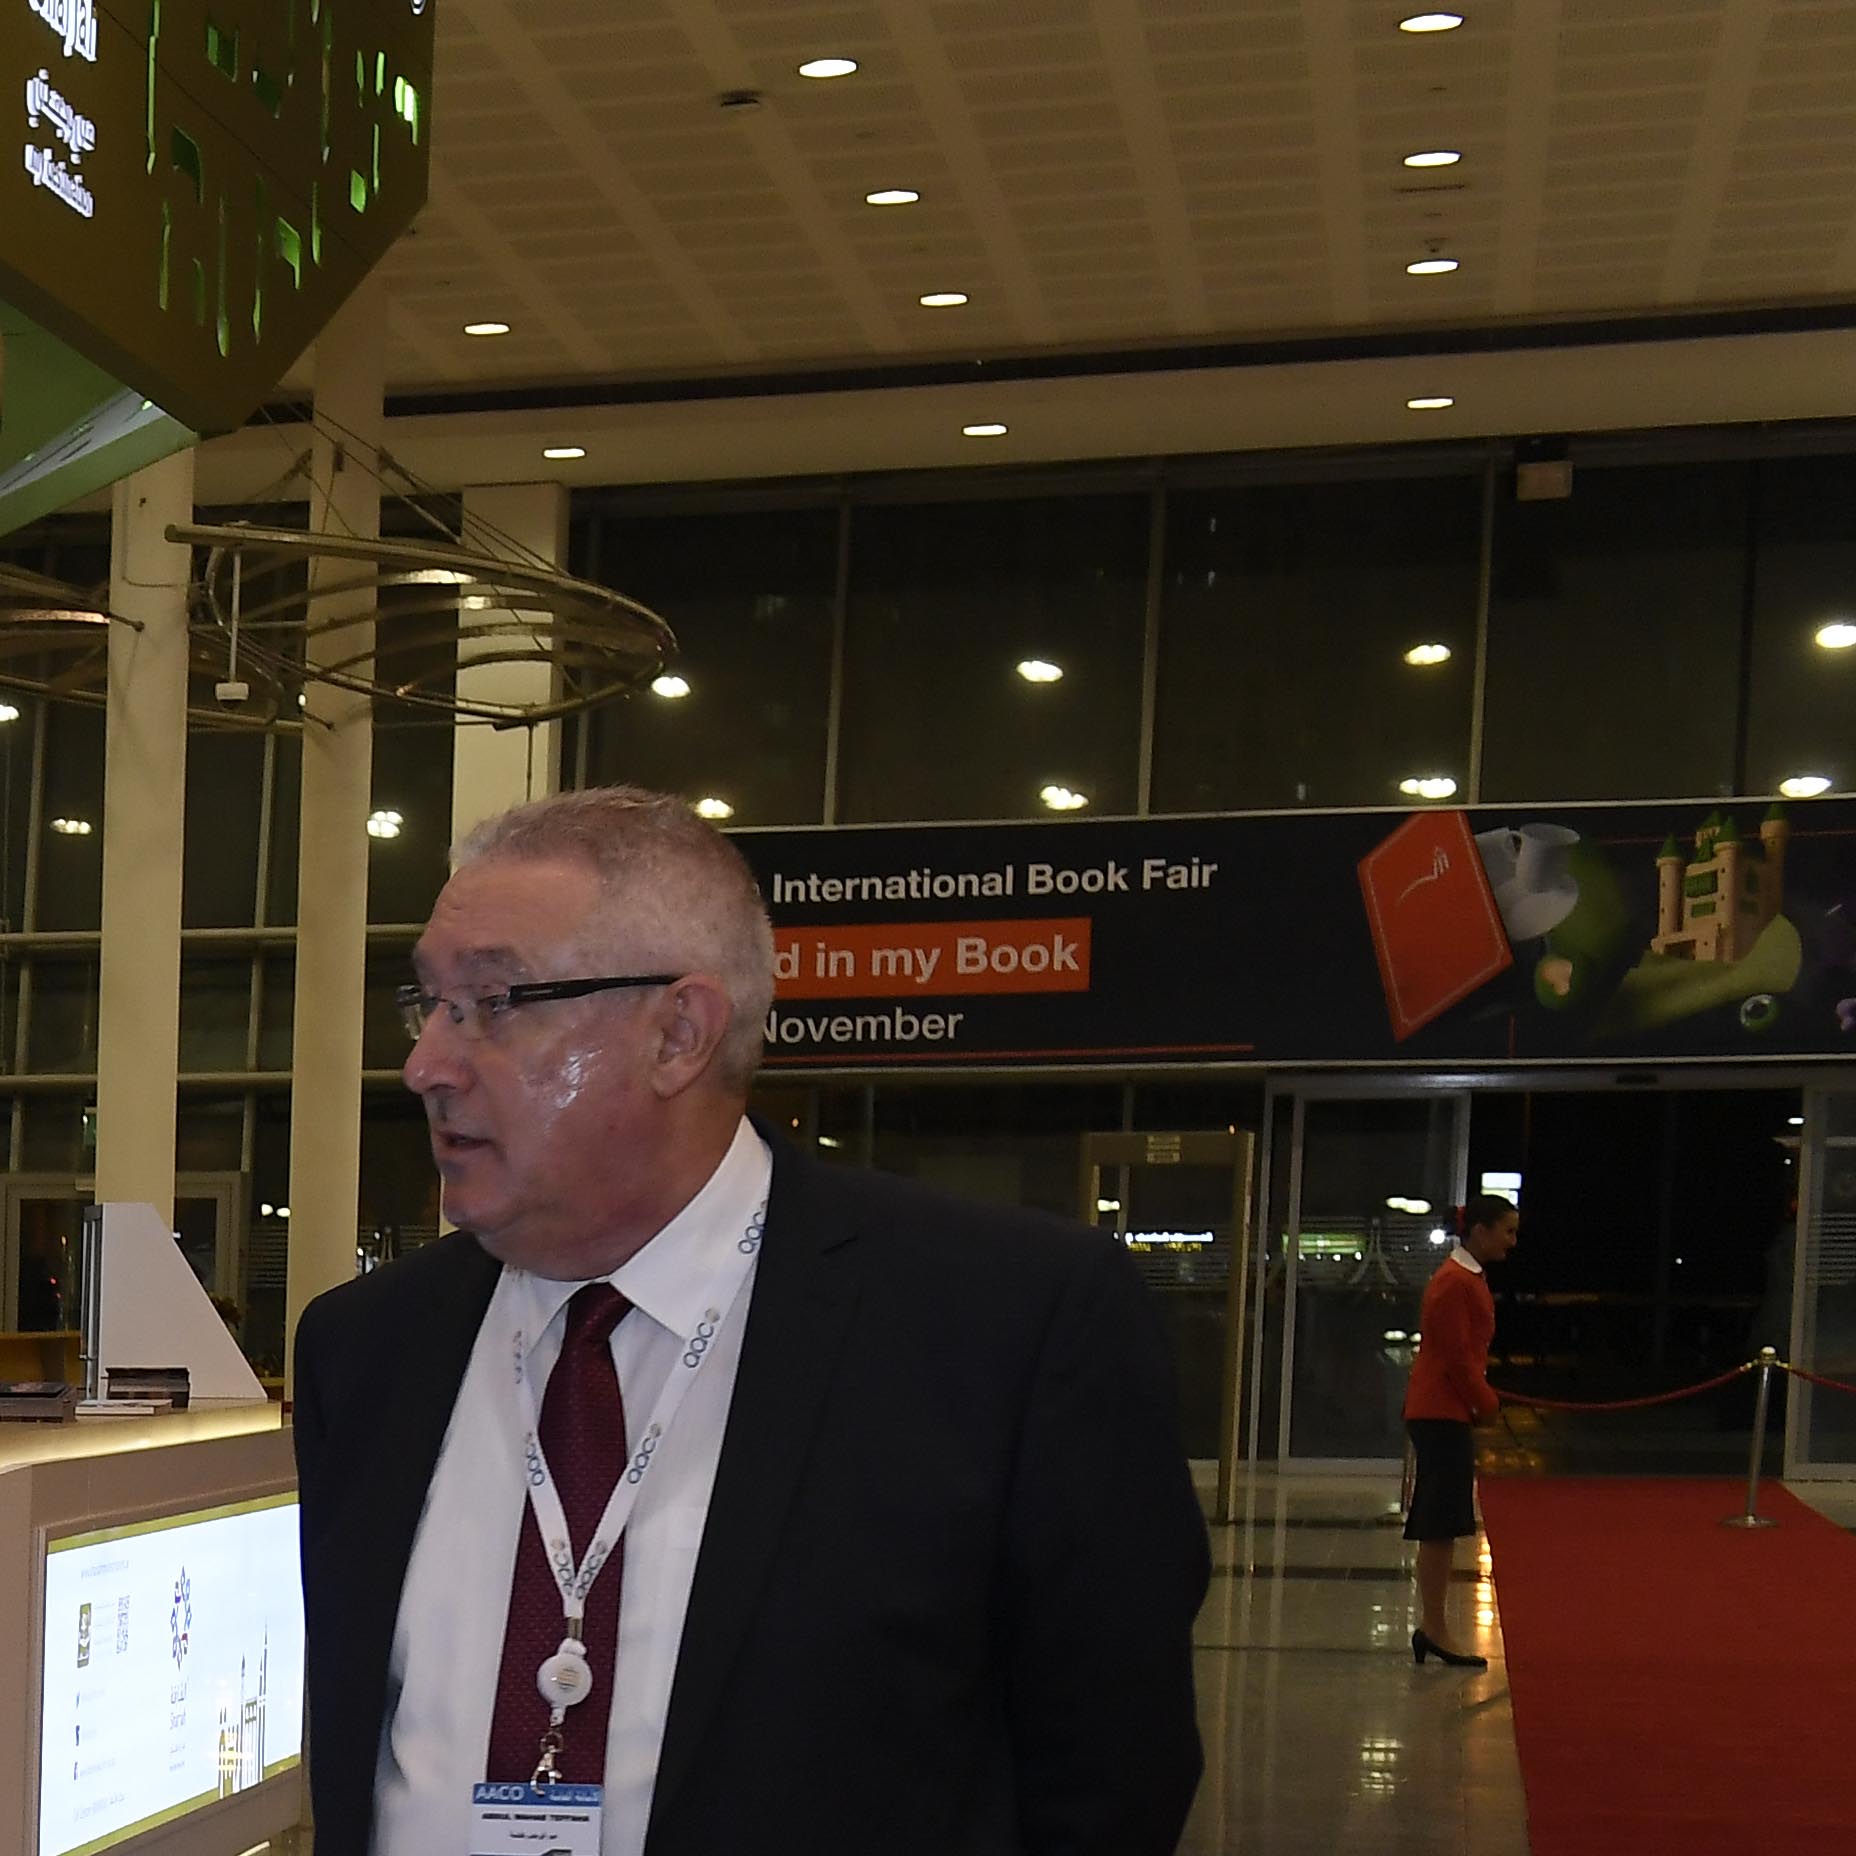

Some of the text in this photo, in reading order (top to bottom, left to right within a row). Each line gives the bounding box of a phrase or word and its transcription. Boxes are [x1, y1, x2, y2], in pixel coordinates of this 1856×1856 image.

[772, 862, 1015, 905] International
[1026, 861, 1130, 899] Book
[1141, 855, 1220, 891] Fair
[814, 941, 858, 979] in
[870, 944, 942, 983] my
[955, 934, 1082, 976] Book
